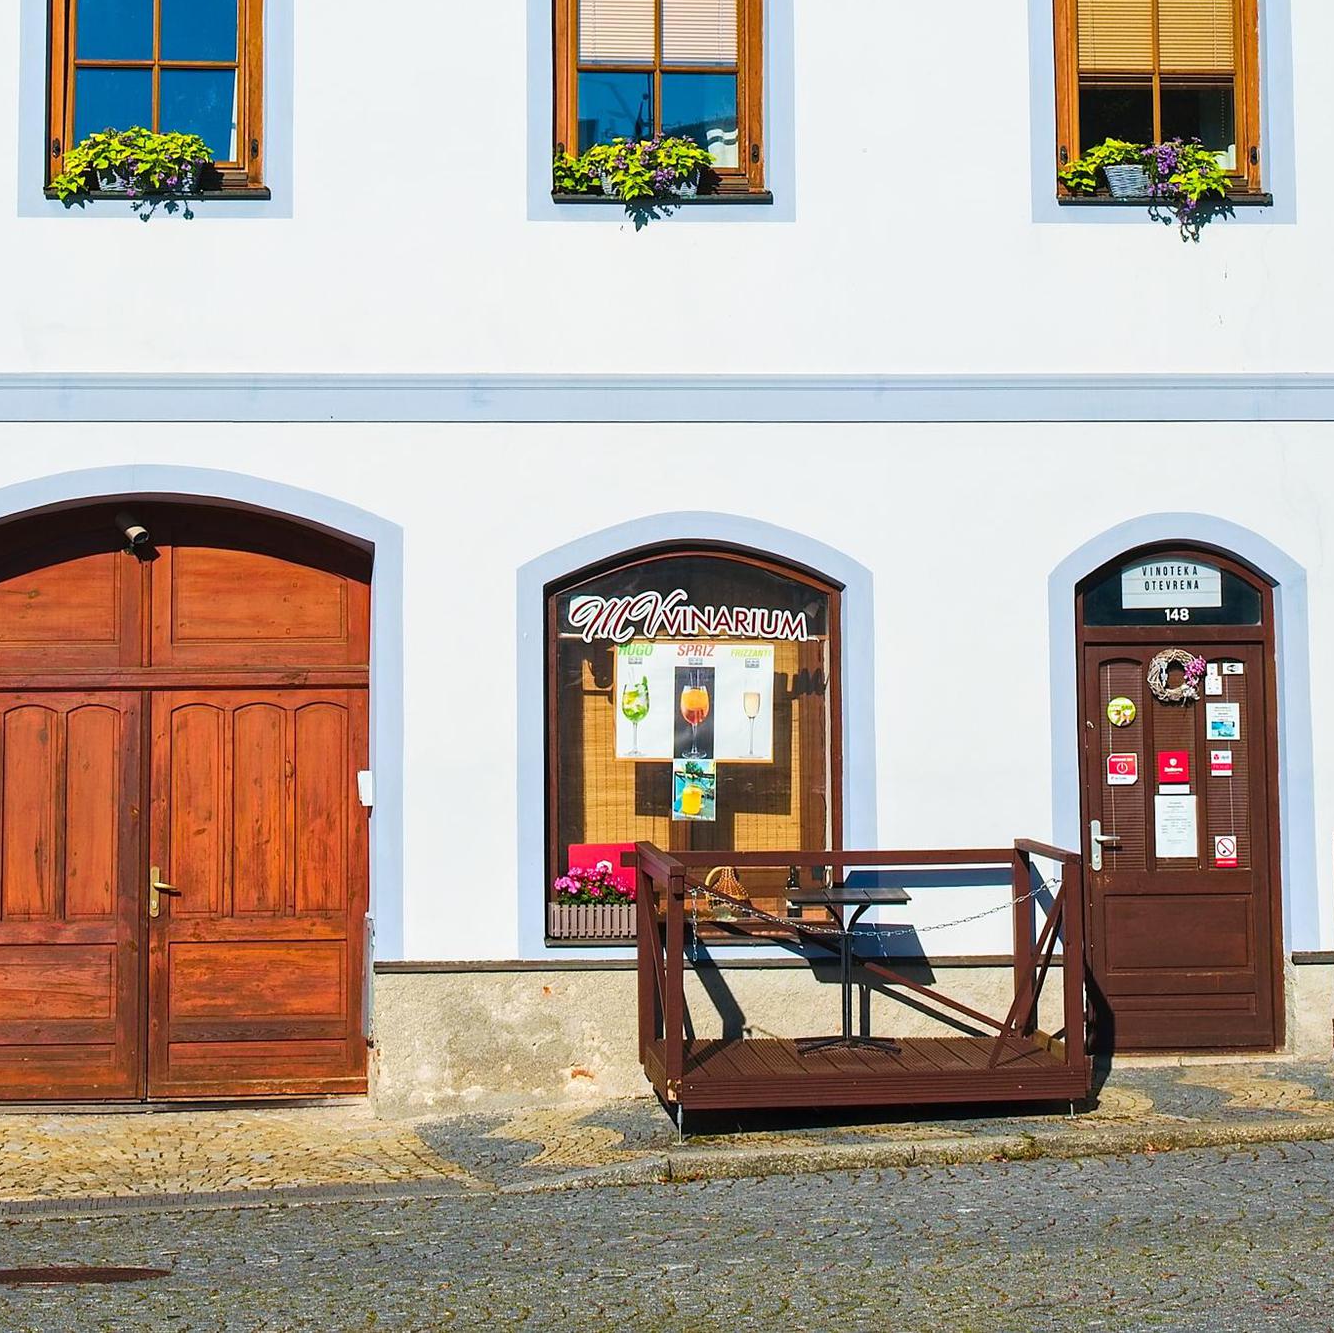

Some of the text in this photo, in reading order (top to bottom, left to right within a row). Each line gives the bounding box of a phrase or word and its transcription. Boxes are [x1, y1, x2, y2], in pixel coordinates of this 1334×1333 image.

[1142, 566, 1198, 576] VINOTEKA
[1144, 580, 1199, 591] OTEVRENA
[1164, 608, 1190, 622] 148
[661, 606, 809, 642] VINARIUM
[618, 643, 653, 657] HUGO
[677, 643, 717, 657] SPRIZ
